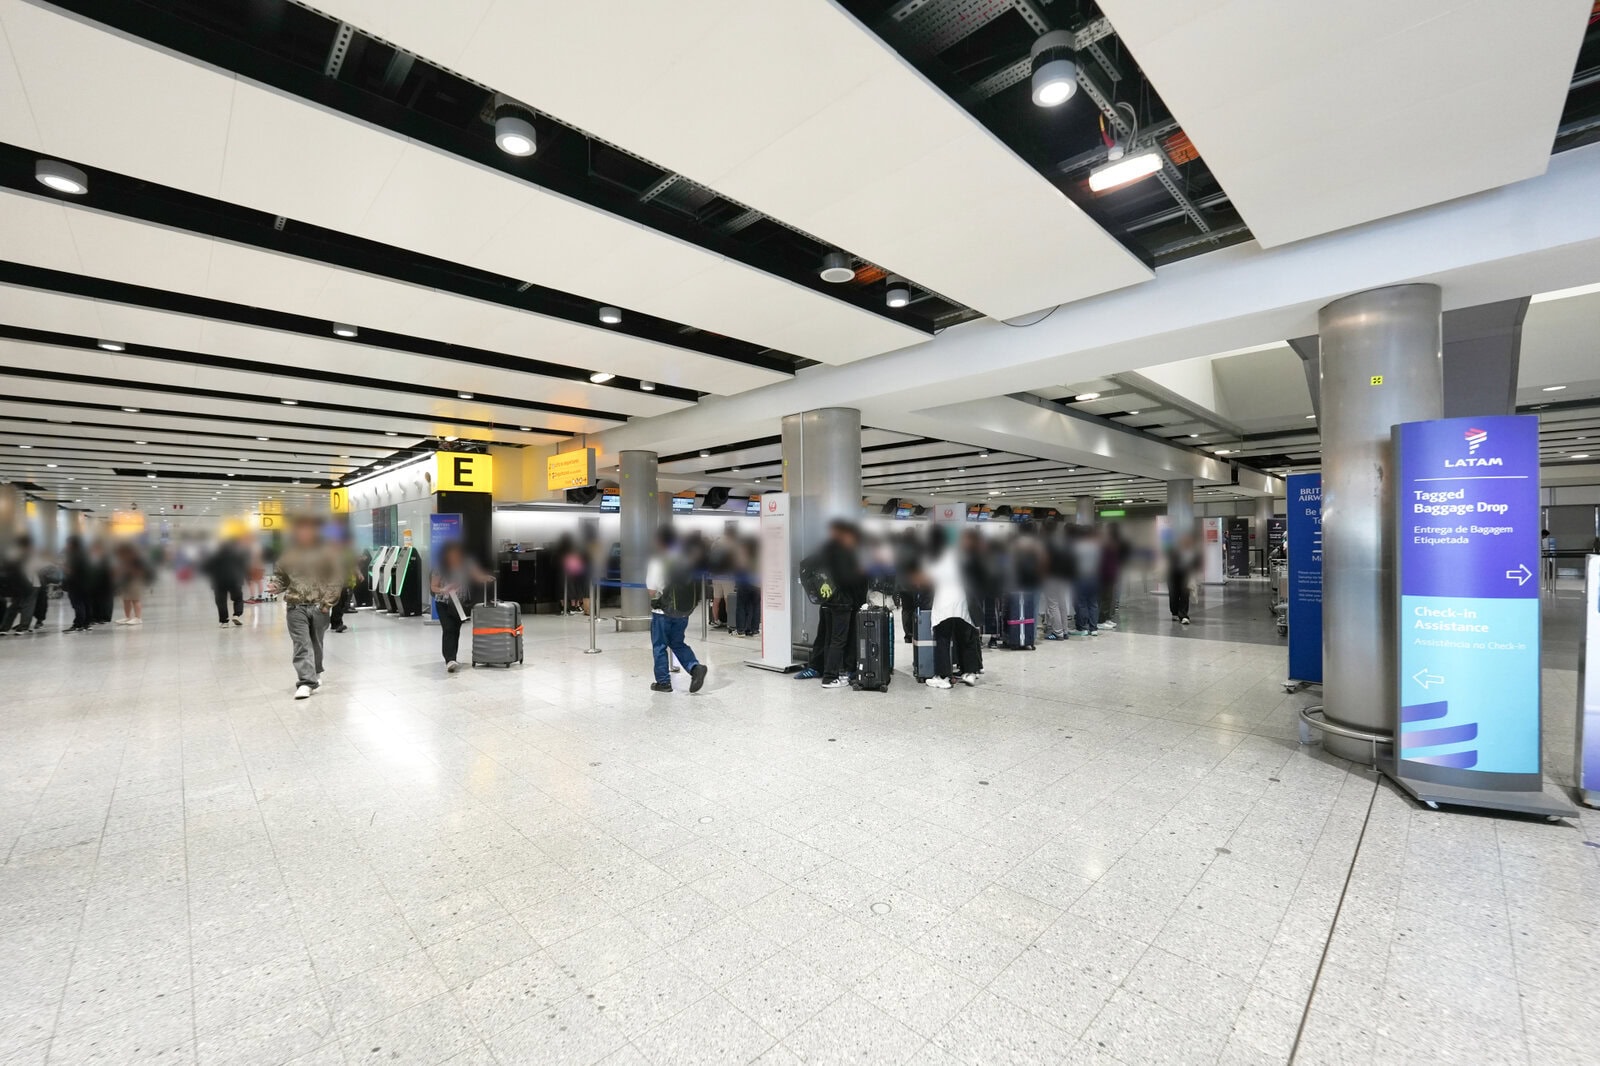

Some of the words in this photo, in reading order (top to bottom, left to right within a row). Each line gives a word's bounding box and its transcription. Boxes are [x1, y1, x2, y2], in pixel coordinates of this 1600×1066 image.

[1444, 458, 1503, 468] LATAM
[454, 457, 473, 486] E
[333, 492, 340, 509] D
[1414, 489, 1464, 502] Tagged
[1414, 502, 1474, 516] Baggage
[1477, 502, 1508, 514] Drop
[1414, 526, 1453, 535] Entrega
[1455, 525, 1468, 533] de
[1470, 525, 1513, 535] Bagagem
[1414, 536, 1469, 545] Etiquetada
[1414, 606, 1477, 619] Check-in
[1414, 619, 1489, 632] Assistance
[1414, 638, 1470, 649] Assistência
[1487, 641, 1527, 650] Check-in
